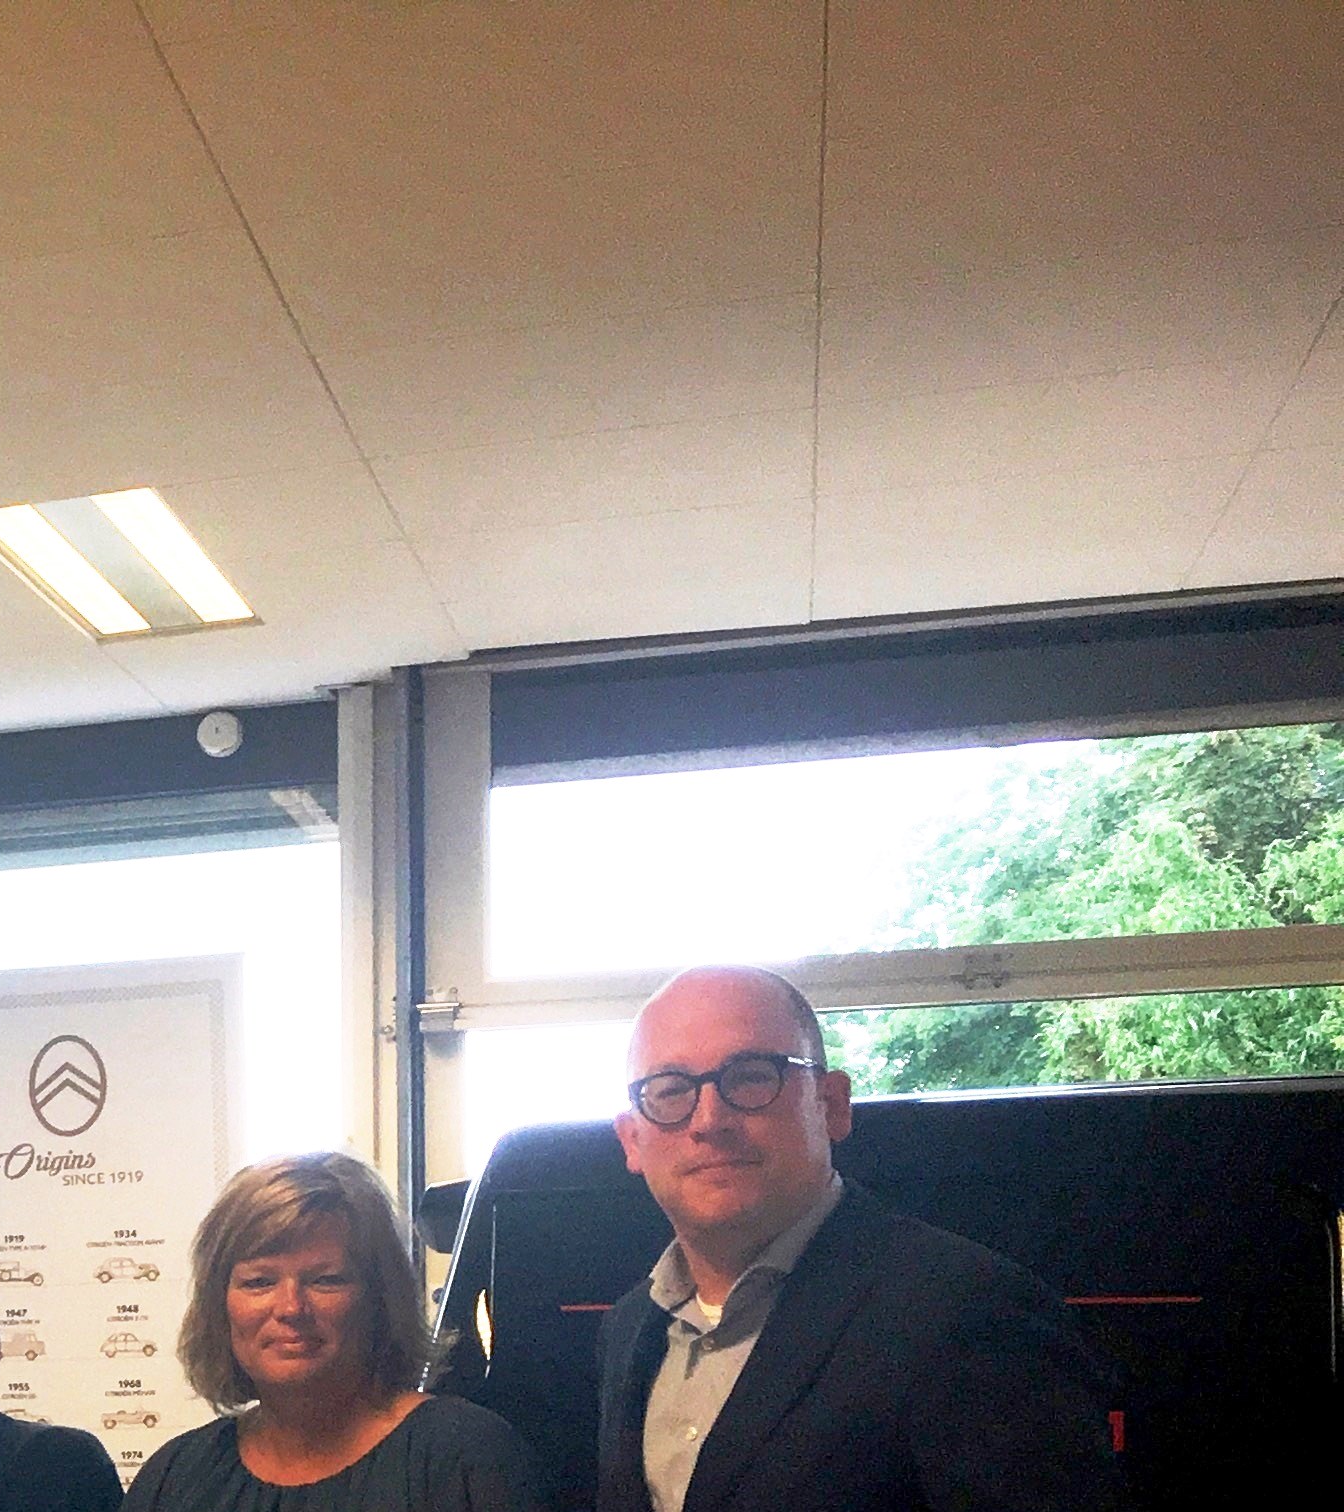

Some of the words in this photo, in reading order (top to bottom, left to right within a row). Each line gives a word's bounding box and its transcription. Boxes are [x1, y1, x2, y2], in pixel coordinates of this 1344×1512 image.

[63, 1172, 105, 1186] SINCE
[109, 1170, 144, 1184] 1919
[113, 1230, 137, 1238] 1934
[4, 1235, 25, 1243] 1919
[5, 1309, 28, 1317] 1947
[8, 1383, 30, 1391] 1955
[118, 1379, 142, 1388] 1968
[121, 1451, 143, 1459] 1974
